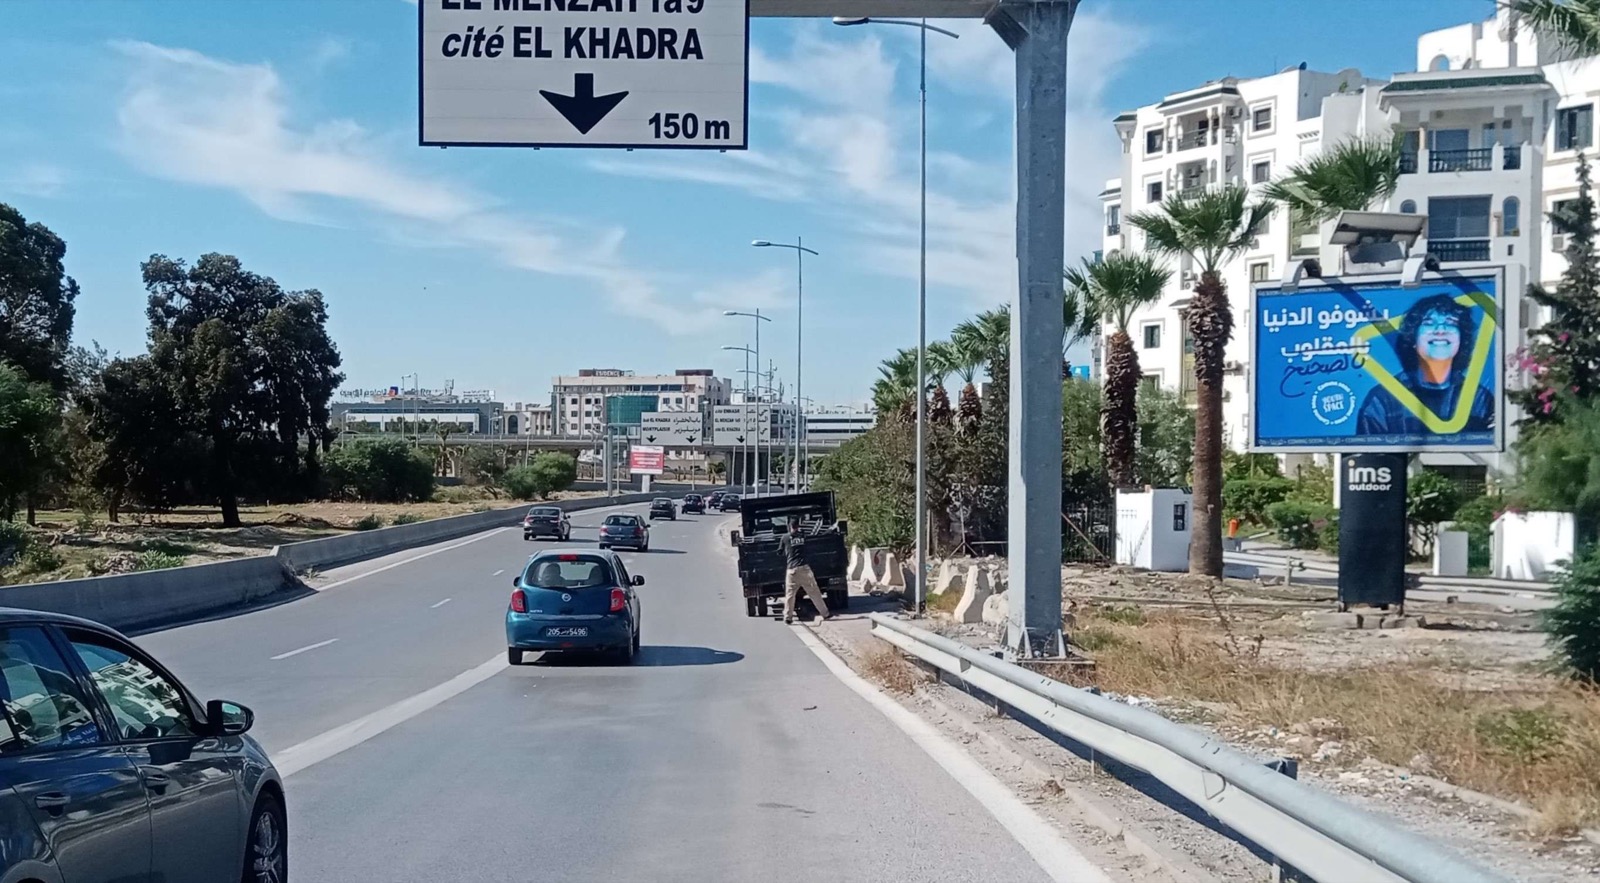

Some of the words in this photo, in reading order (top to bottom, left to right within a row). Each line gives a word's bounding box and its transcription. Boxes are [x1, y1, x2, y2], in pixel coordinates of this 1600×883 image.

[442, 25, 504, 58] cité
[513, 26, 552, 58] EL
[564, 27, 704, 59] KHADRA
[648, 112, 699, 139] 150
[704, 120, 730, 140] m
[1263, 306, 1313, 333] الدنيا
[1281, 336, 1371, 363] بالمقلوب
[1323, 400, 1344, 413] SPACE
[1348, 459, 1392, 483] ims
[1349, 483, 1392, 491] outdoor
